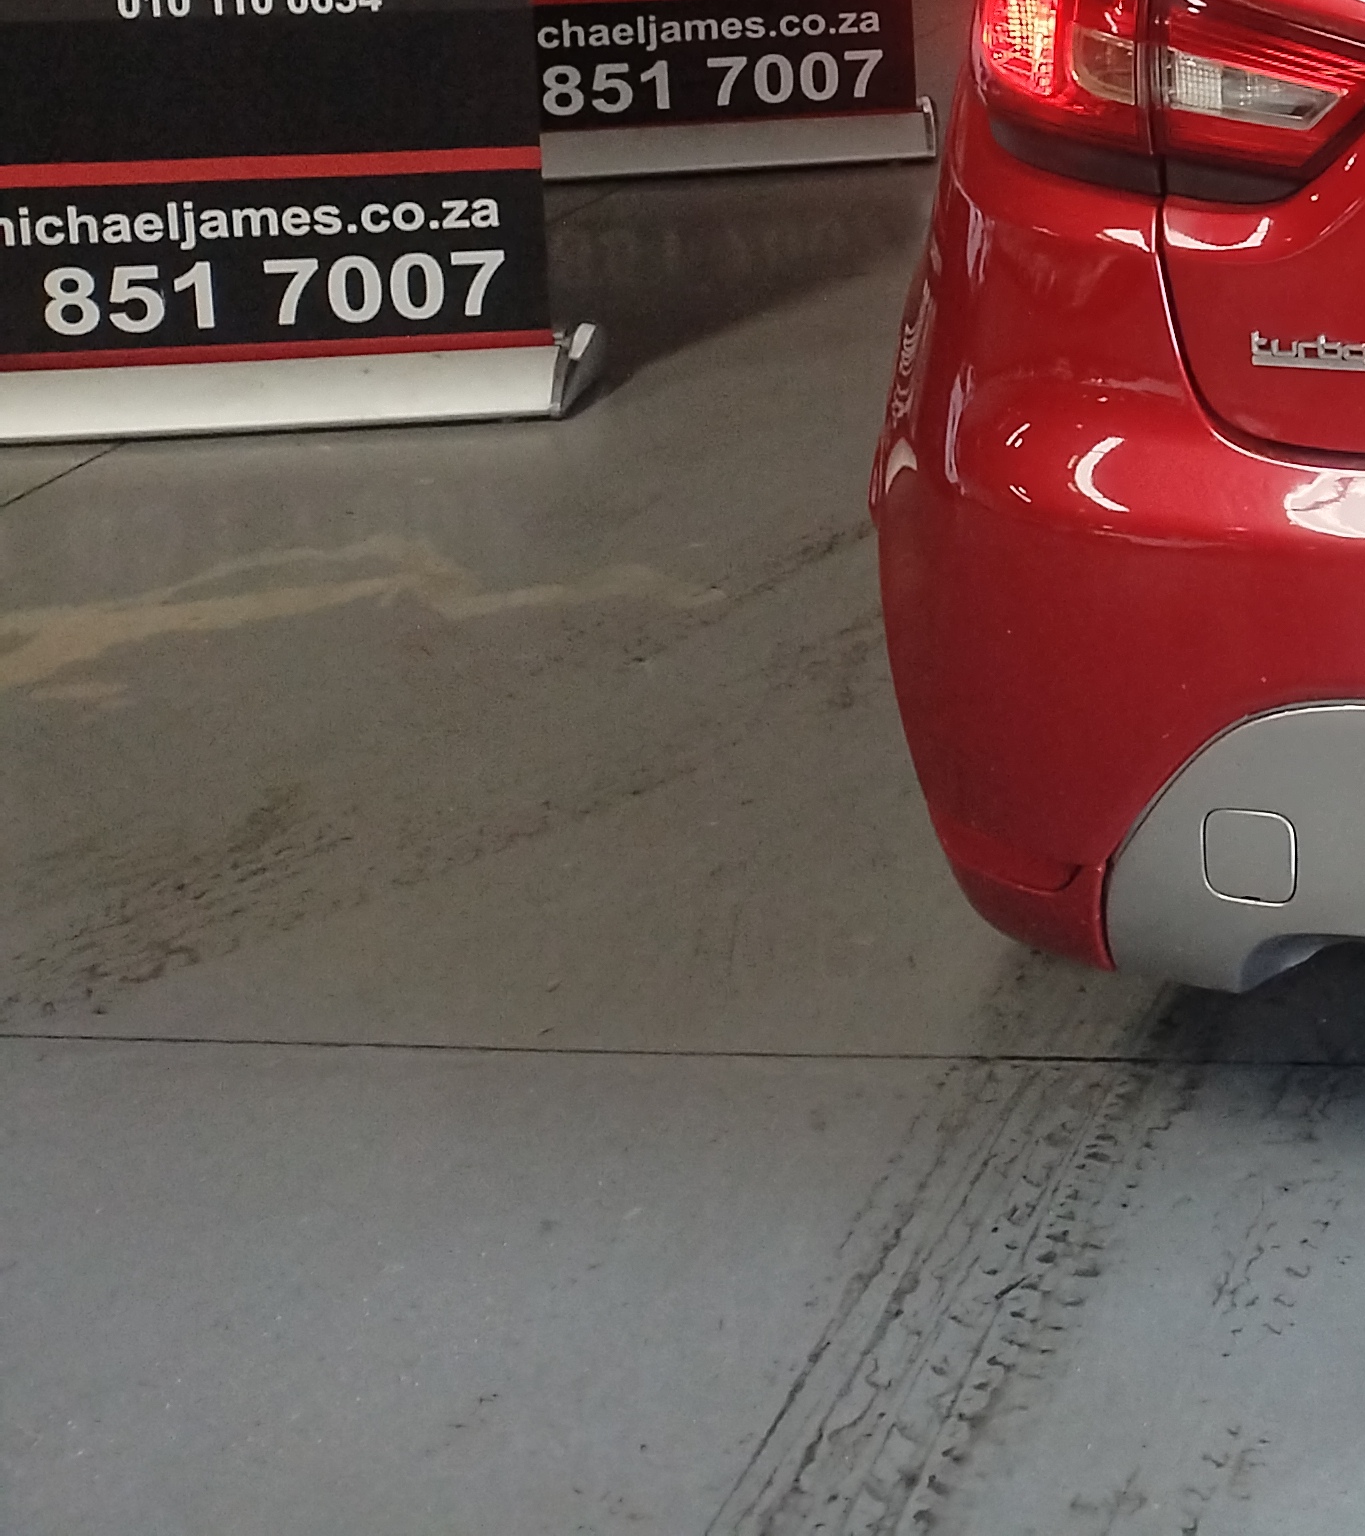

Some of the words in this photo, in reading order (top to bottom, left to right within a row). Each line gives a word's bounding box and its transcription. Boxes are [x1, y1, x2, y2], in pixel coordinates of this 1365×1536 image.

[538, 12, 879, 51] chaeljames.co.za
[543, 60, 670, 115] 851
[707, 49, 883, 106] 7007
[44, 261, 215, 335] 851
[263, 250, 504, 325] 7007
